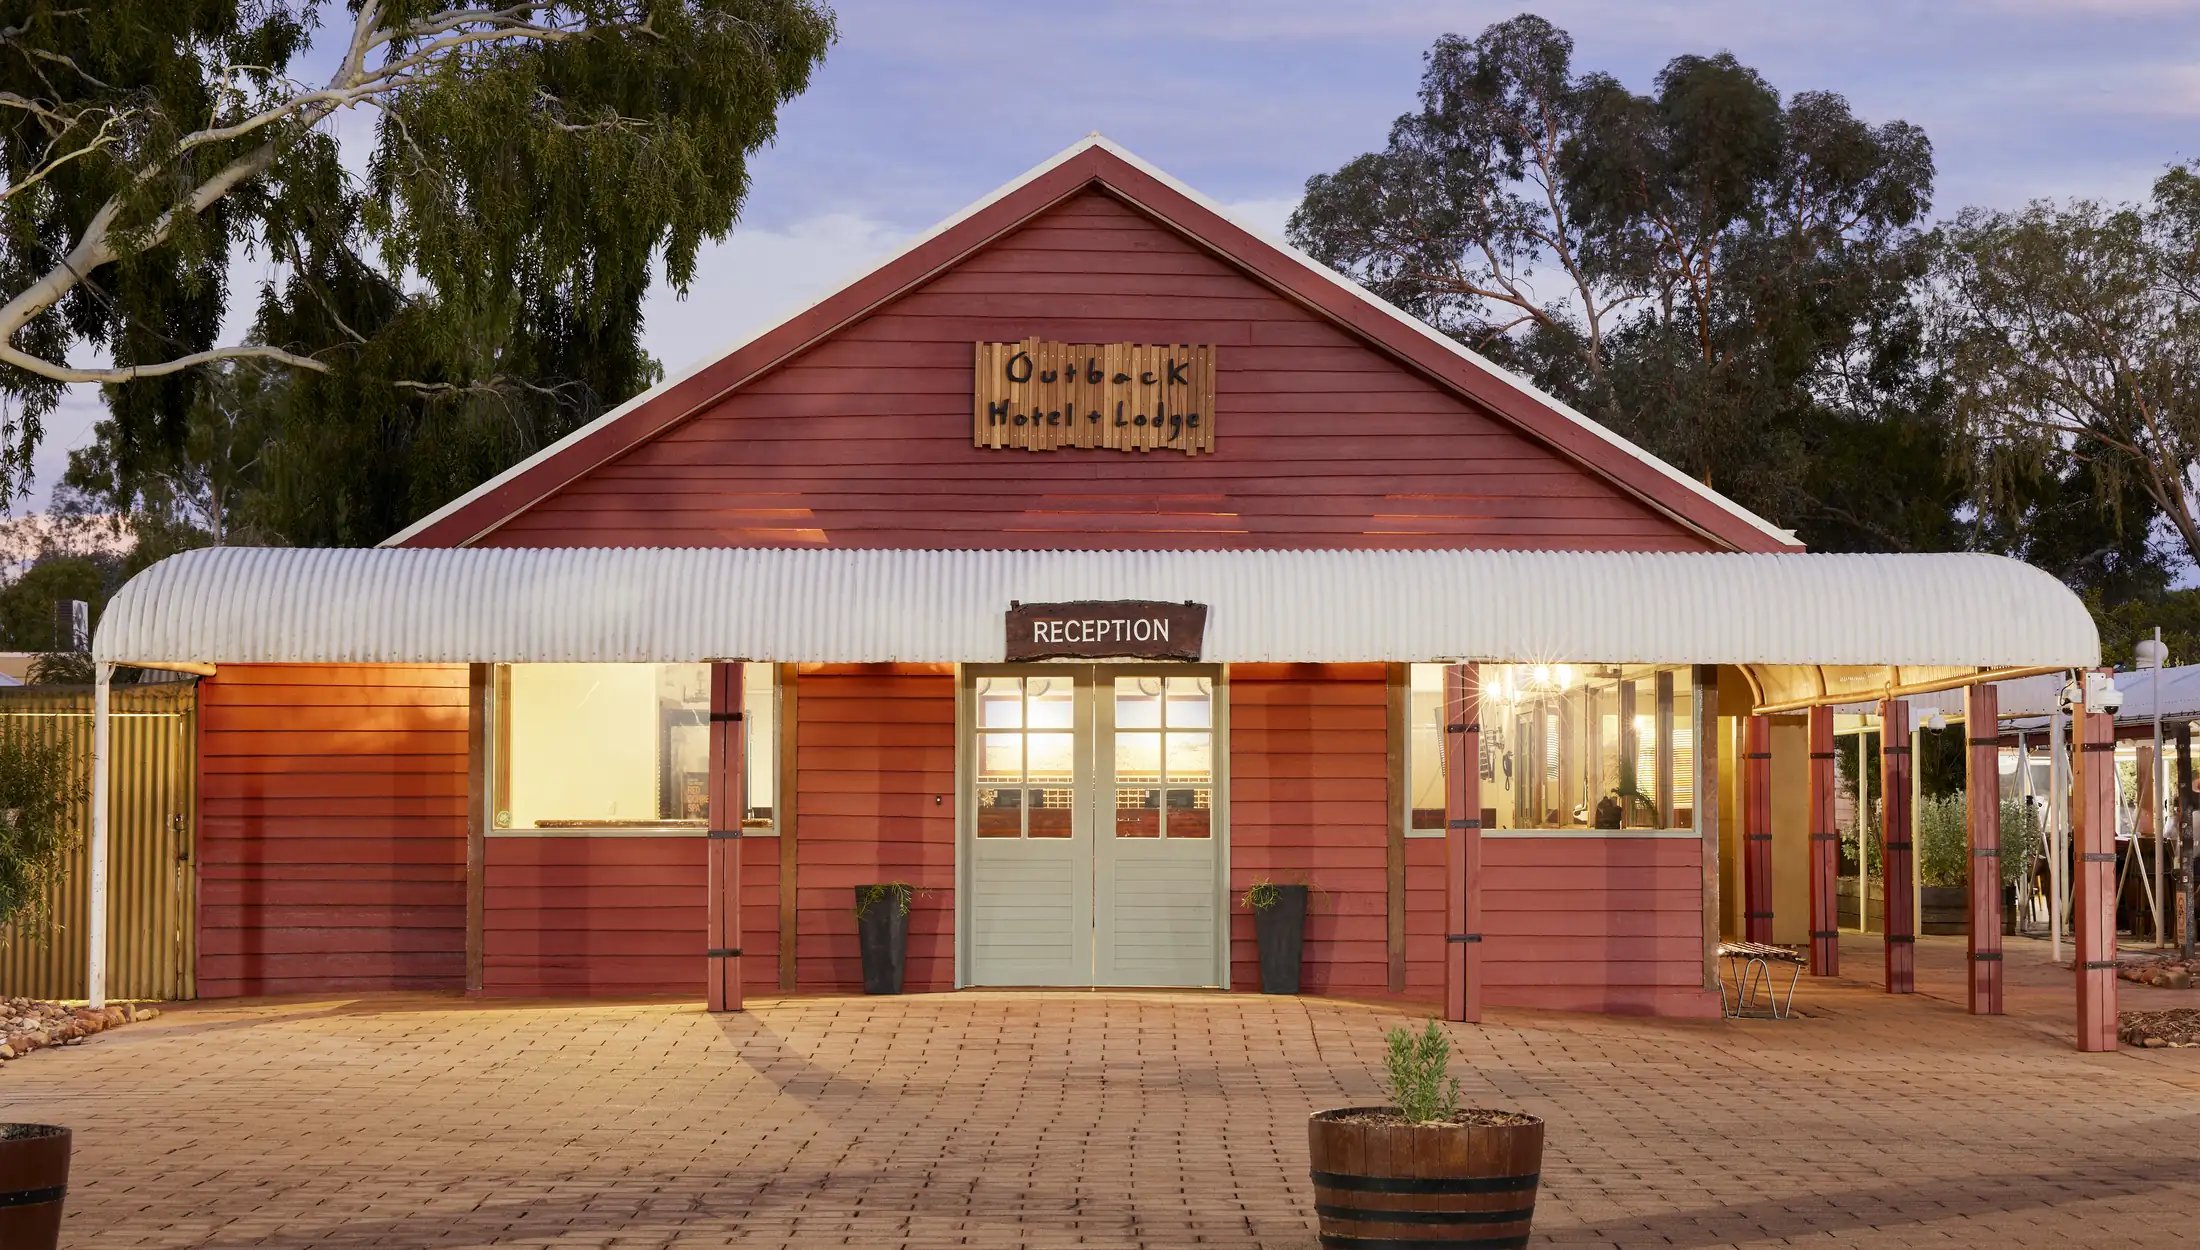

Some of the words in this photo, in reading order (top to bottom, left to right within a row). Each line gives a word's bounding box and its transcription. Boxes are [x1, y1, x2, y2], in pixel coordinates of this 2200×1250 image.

[989, 400, 1073, 427] Hotel
[1114, 401, 1200, 441] Lodge
[1033, 619, 1169, 643] RECEPTION
